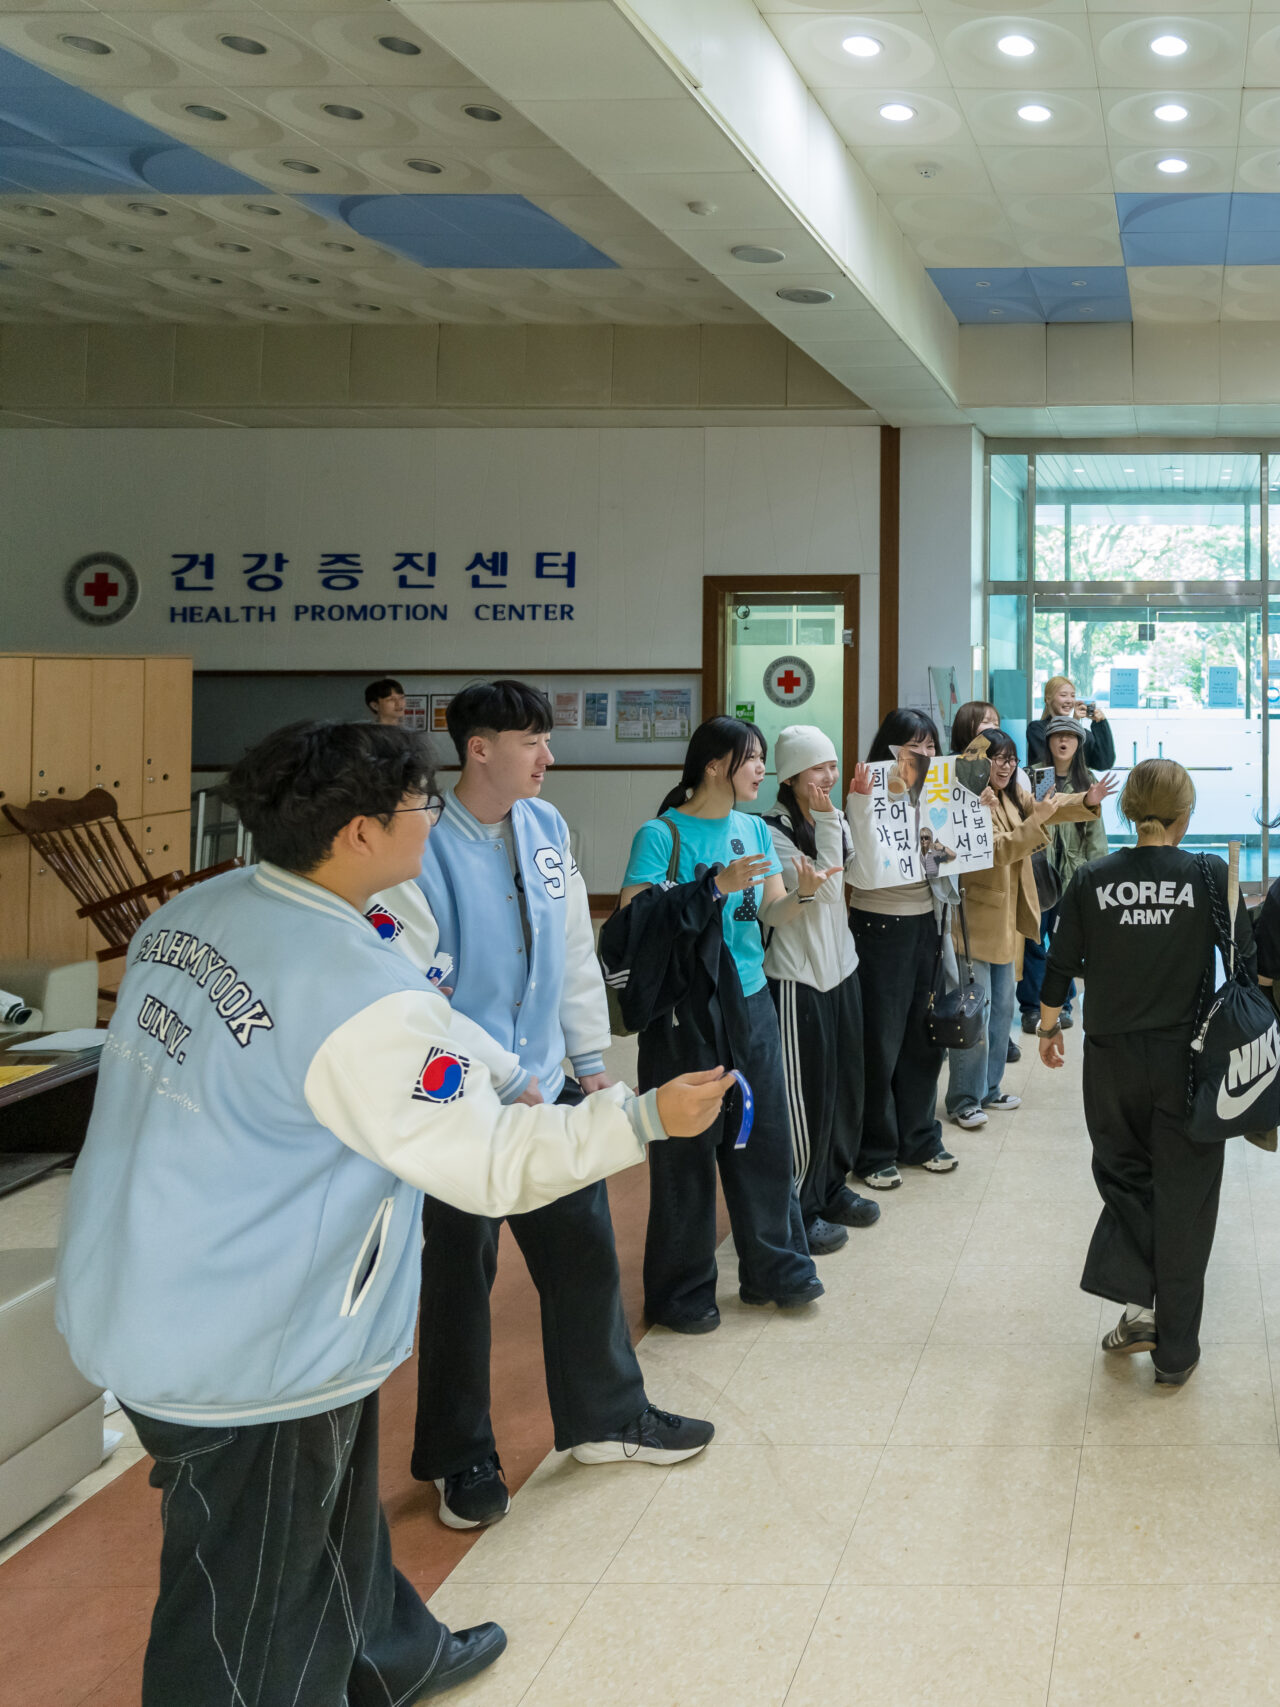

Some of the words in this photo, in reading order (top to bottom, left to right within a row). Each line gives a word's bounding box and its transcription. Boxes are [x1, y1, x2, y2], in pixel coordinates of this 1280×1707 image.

[171, 551, 577, 592] 건강증진센터
[169, 605, 276, 623] HEALTH
[295, 603, 448, 622] PROMOTION
[474, 603, 575, 622] CENTER
[890, 801, 914, 877] 어딨어
[533, 846, 566, 900] S
[1096, 881, 1195, 911] KOREA
[1119, 908, 1175, 925] ARMY
[137, 994, 192, 1066] UNV.
